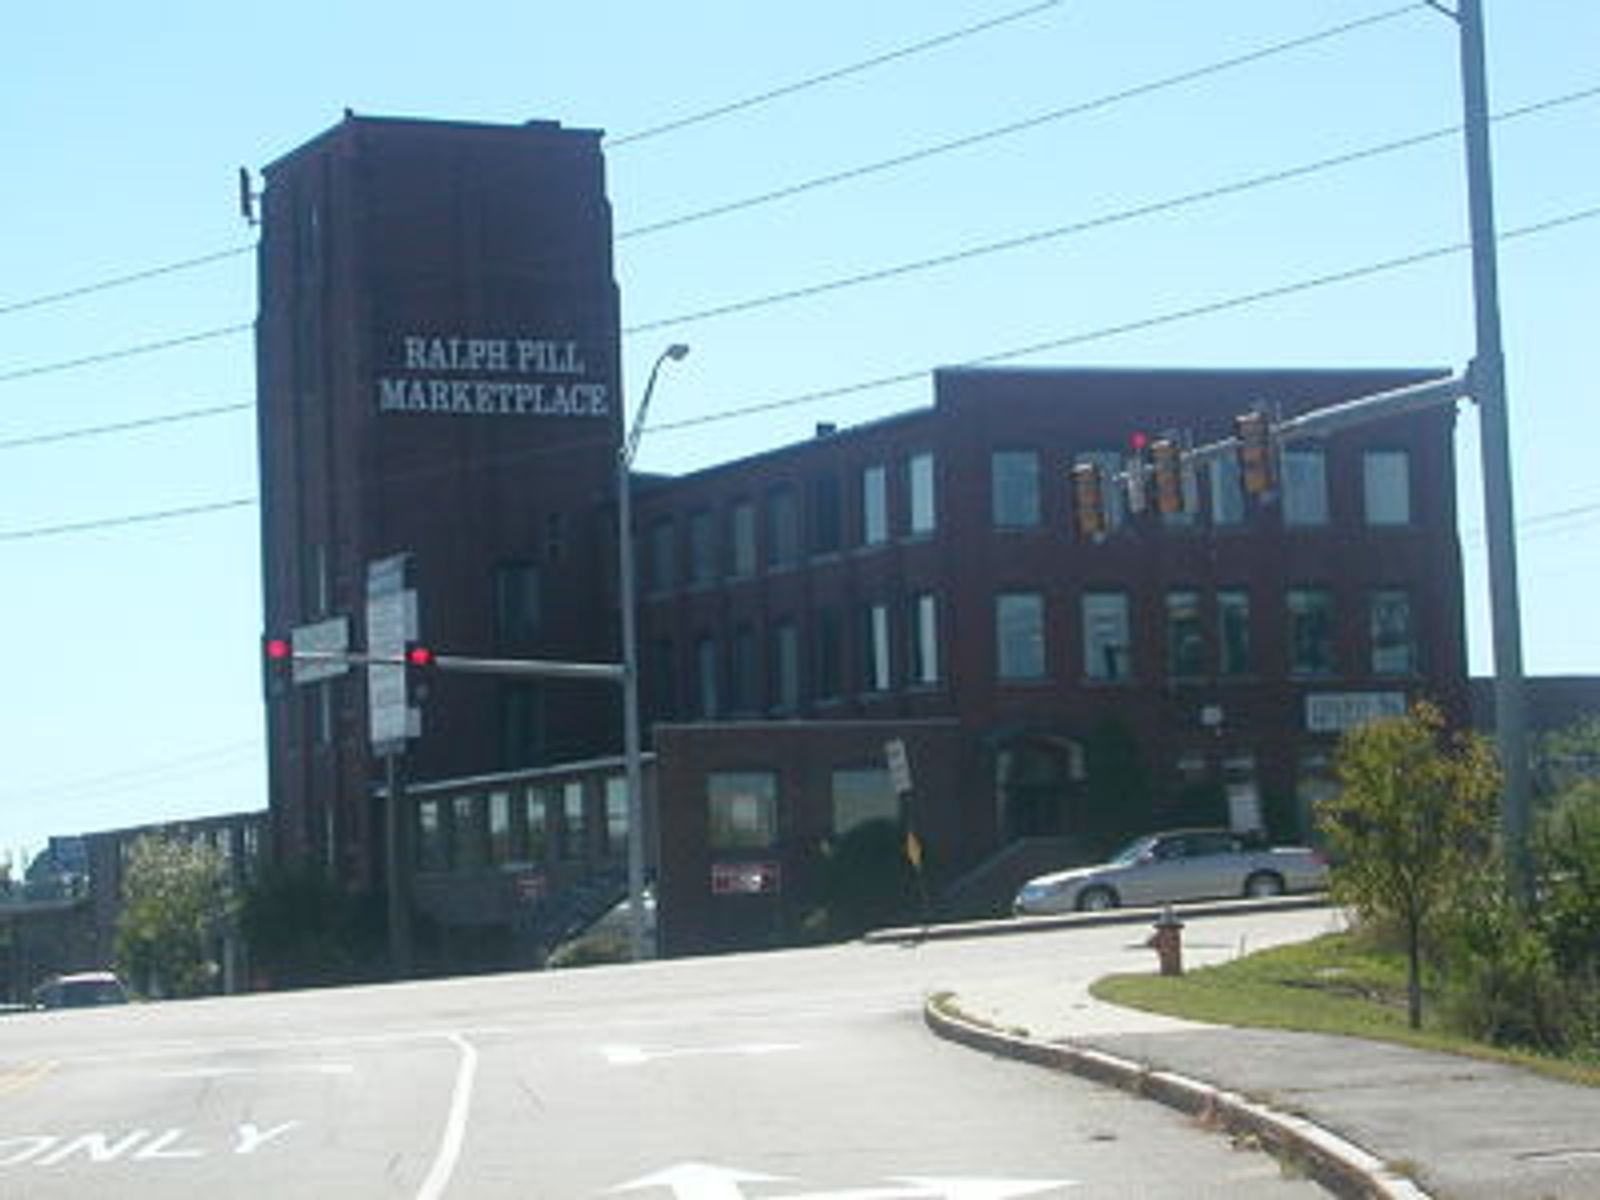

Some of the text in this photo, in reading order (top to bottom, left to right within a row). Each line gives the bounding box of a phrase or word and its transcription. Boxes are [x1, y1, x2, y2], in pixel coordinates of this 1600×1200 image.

[404, 336, 585, 375] RALPH PILL
[379, 378, 609, 416] MARKETPLACE
